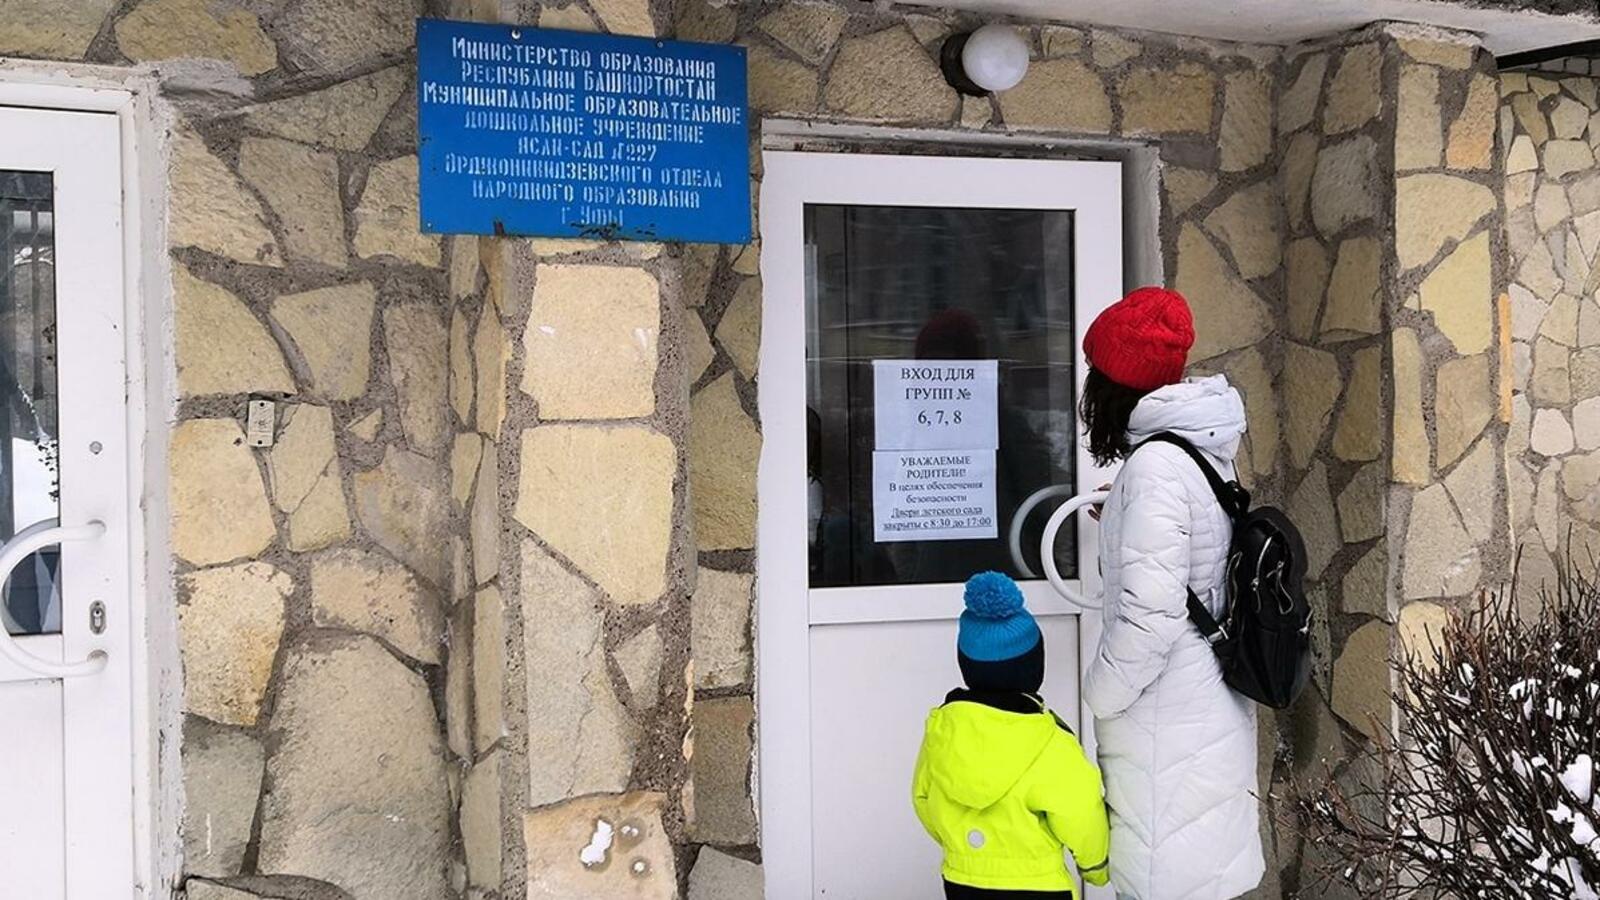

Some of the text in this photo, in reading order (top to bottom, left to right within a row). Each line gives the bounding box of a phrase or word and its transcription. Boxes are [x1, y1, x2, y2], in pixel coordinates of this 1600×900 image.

[452, 37, 716, 79] МИНИСТЕРСТВО ОБРАЗОВАНИЯ
[462, 60, 716, 100] РЕСПУБЛИКИ БАШКОРТОСТАН
[423, 81, 741, 124] МУНИЦИПАЛЬНОЕ ОБРАЗОВАТЕЛЬНОЕ
[464, 111, 703, 144] ДОШКОЛЬНОЕ УЧРЕЖДЕНИЕ
[445, 153, 722, 188] ОРДЖОНИКИДЗЕВСКОГО ОТДЕЛА
[473, 179, 700, 209] НАРОДНОГО ОБРАЗОВАНИЯ
[901, 367, 975, 381] ВХОД ДЛЯ
[905, 387, 972, 400] ГРУПП №
[918, 410, 962, 426] 6, 7, 8
[901, 456, 972, 467] УВАЖАЕМЫЕ
[906, 468, 967, 479] РОДИТЕЛИ!
[889, 481, 983, 492] В целях обеспечения
[905, 494, 967, 504] безопасности
[891, 507, 983, 518] Двери детского сада
[883, 521, 921, 531] закрыты
[929, 519, 951, 528] 8:30
[952, 520, 964, 528] до
[966, 517, 992, 527] 17:00
